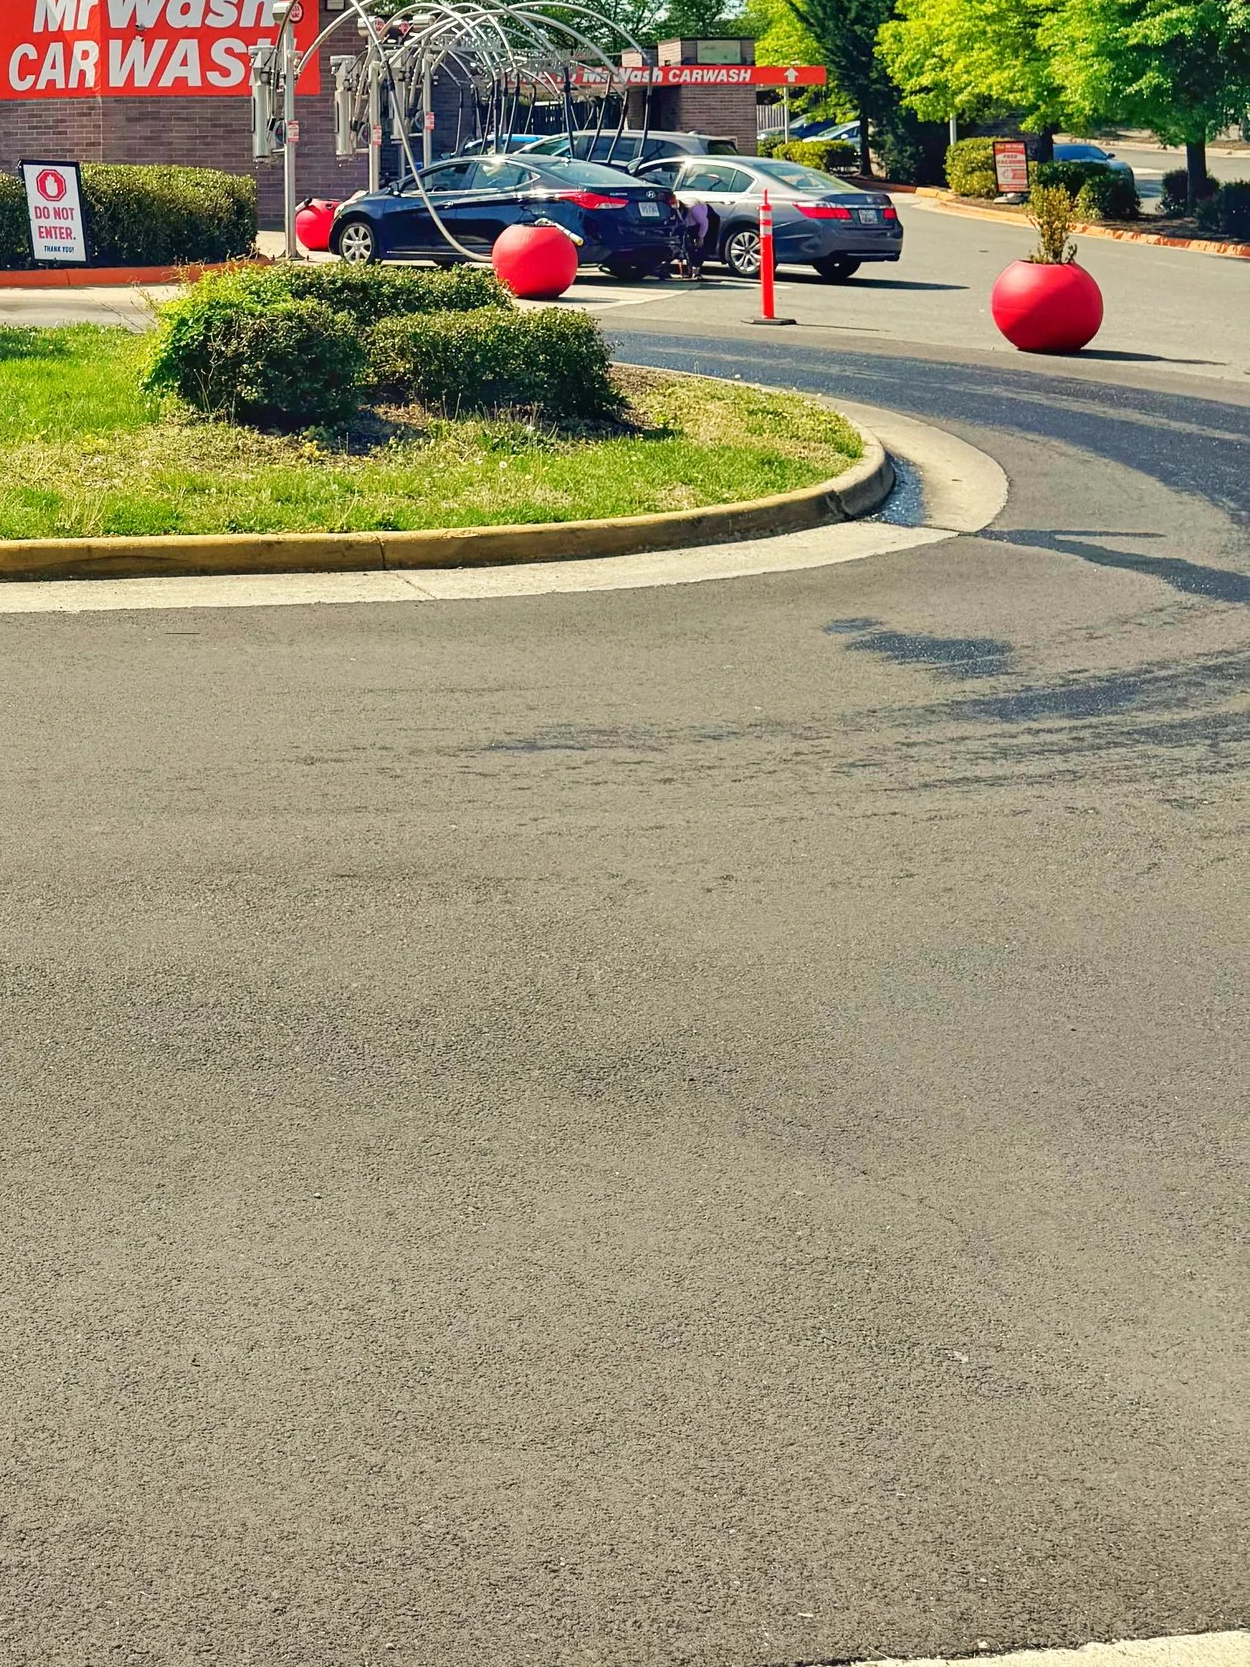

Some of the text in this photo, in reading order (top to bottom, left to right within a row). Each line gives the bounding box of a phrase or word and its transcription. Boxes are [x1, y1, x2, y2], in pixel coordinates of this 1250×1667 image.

[9, 40, 100, 91] CAR
[612, 68, 664, 83] Wash
[668, 69, 751, 83] CARWASH
[34, 206, 75, 221] DO NOT
[38, 225, 76, 241] ENTER.
[44, 245, 61, 253] THANK
